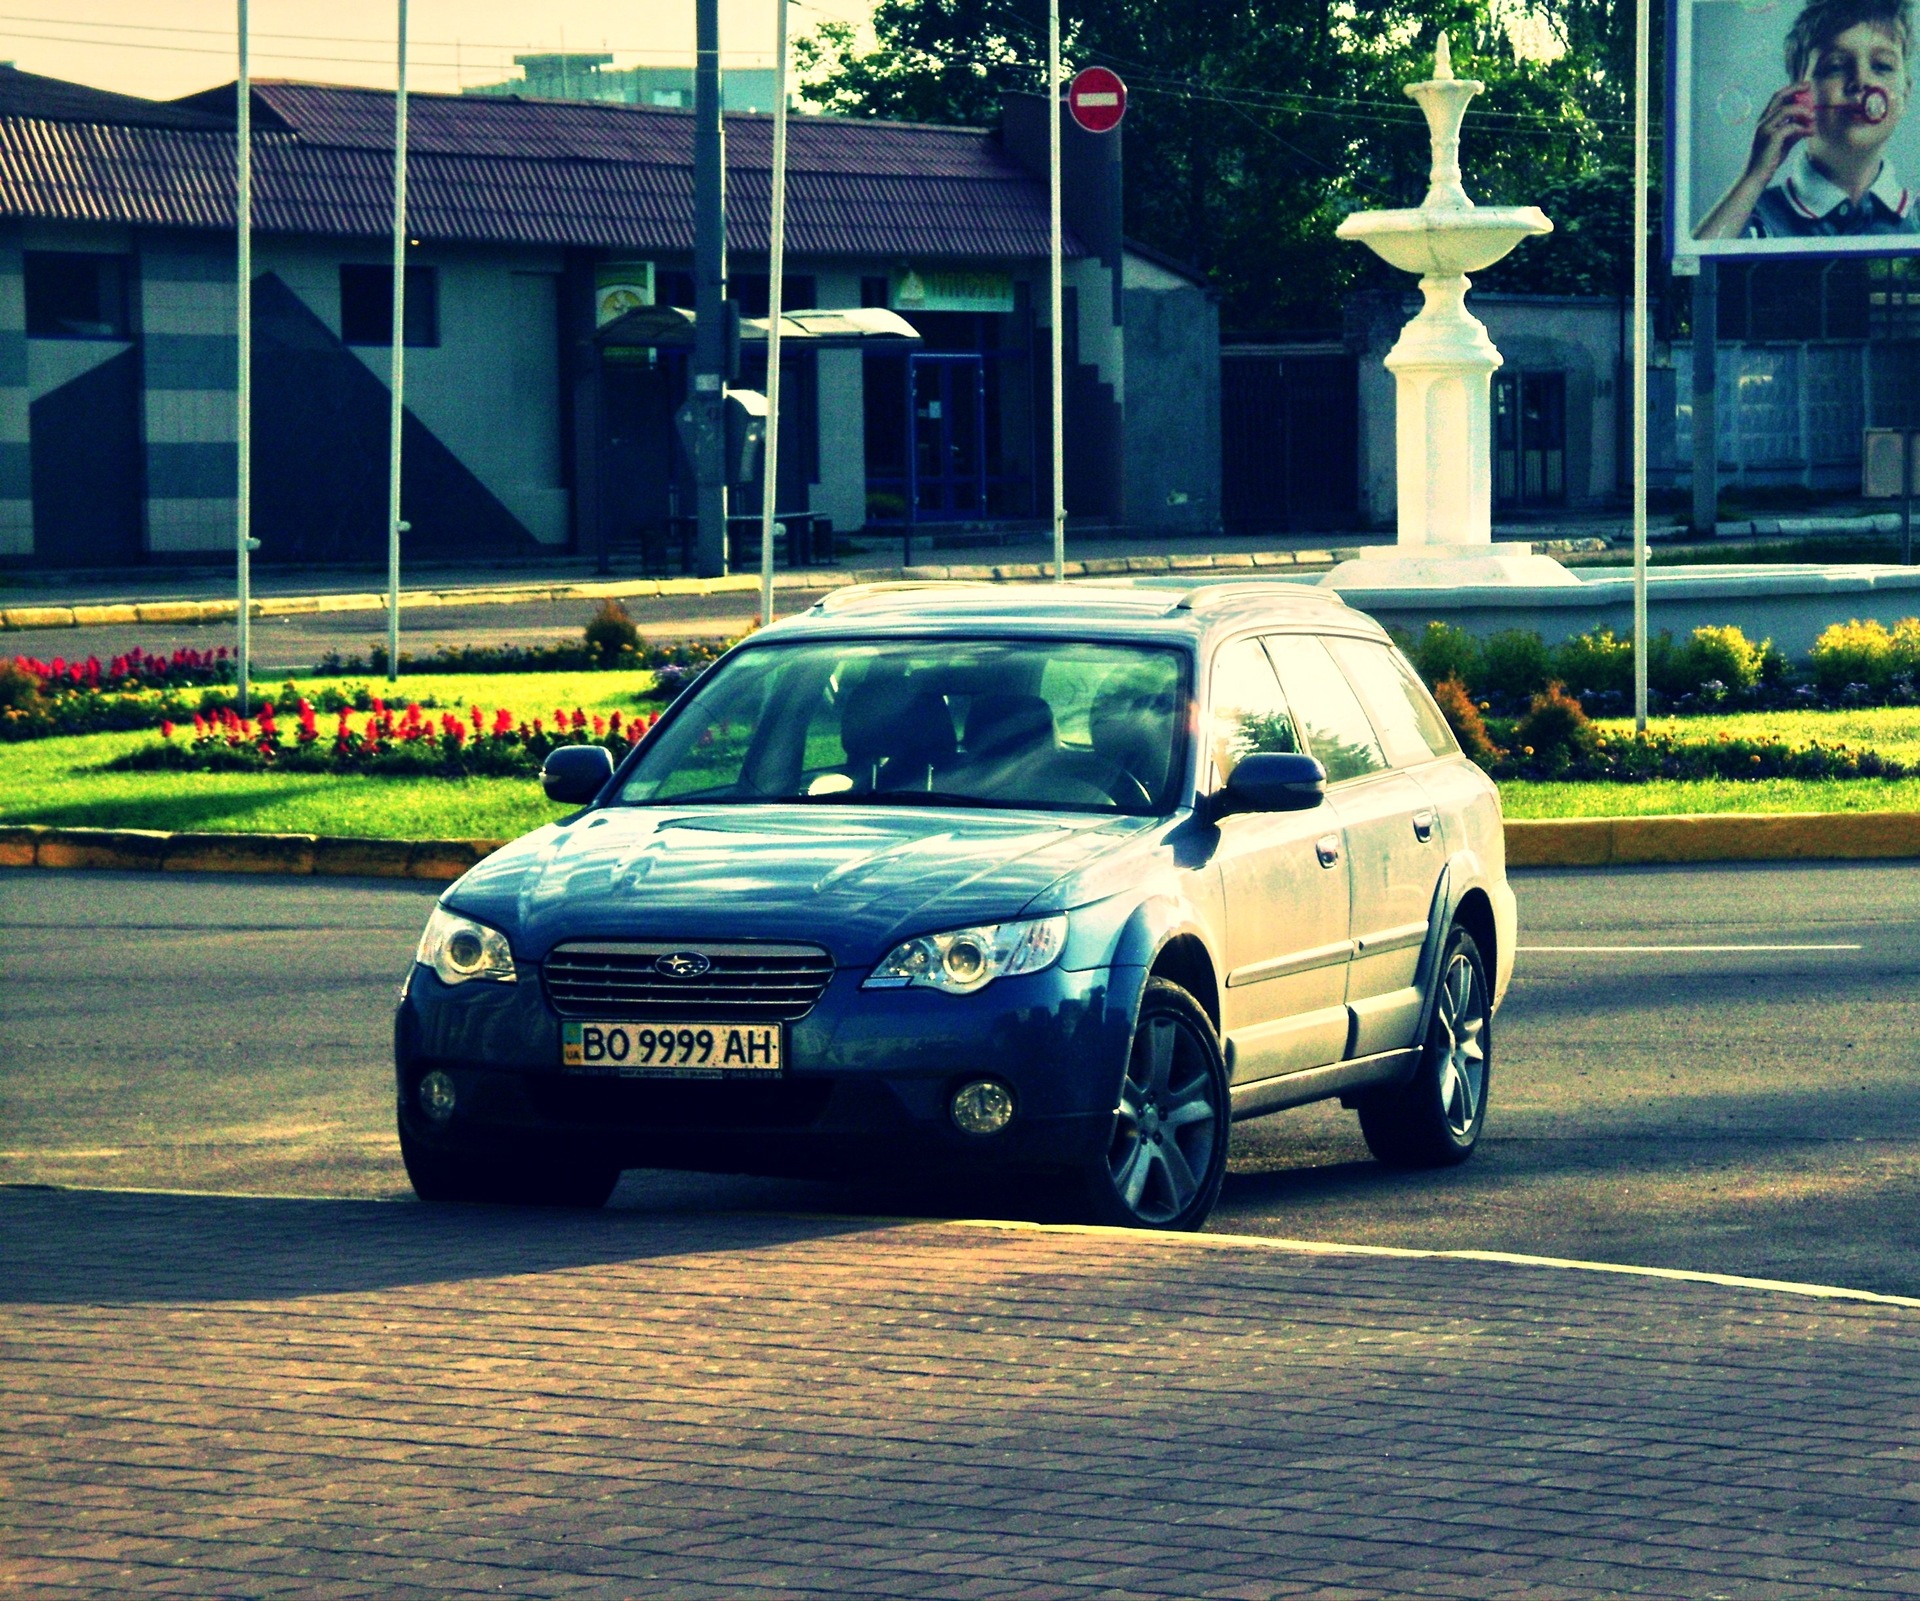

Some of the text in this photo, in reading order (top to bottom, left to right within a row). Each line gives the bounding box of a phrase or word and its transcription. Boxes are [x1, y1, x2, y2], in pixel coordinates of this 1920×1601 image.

[566, 1051, 580, 1060] UA
[583, 1028, 770, 1064] BO 9999 AH
